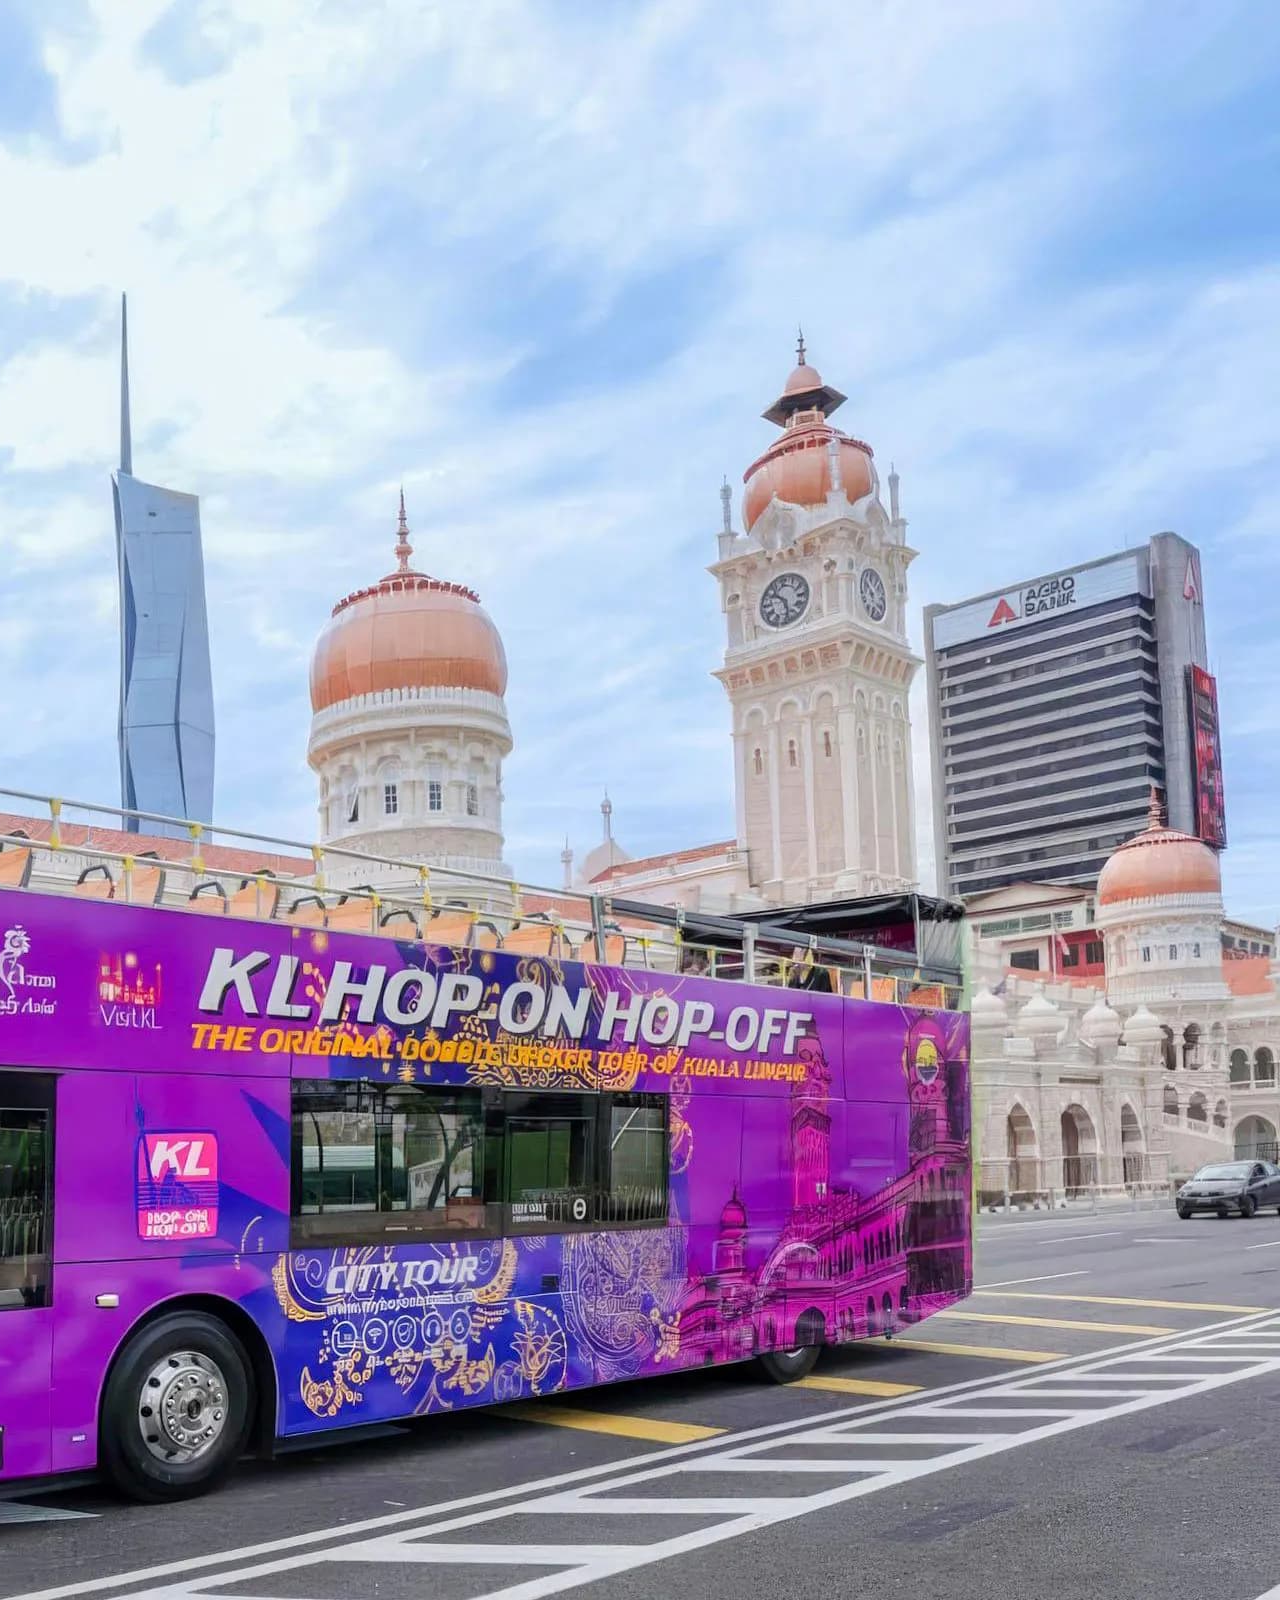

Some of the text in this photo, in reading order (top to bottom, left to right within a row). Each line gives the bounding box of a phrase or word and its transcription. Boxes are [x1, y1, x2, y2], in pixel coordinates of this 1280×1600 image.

[140, 1007, 163, 1029] KL
[199, 948, 813, 1055] KL HOP-ON HOP-OFF
[192, 1023, 257, 1052] THE
[259, 1027, 395, 1060] ORIGINAL
[683, 1057, 739, 1078] KUALA
[150, 1141, 210, 1178] KL
[326, 1256, 479, 1294] CITY TOUR
